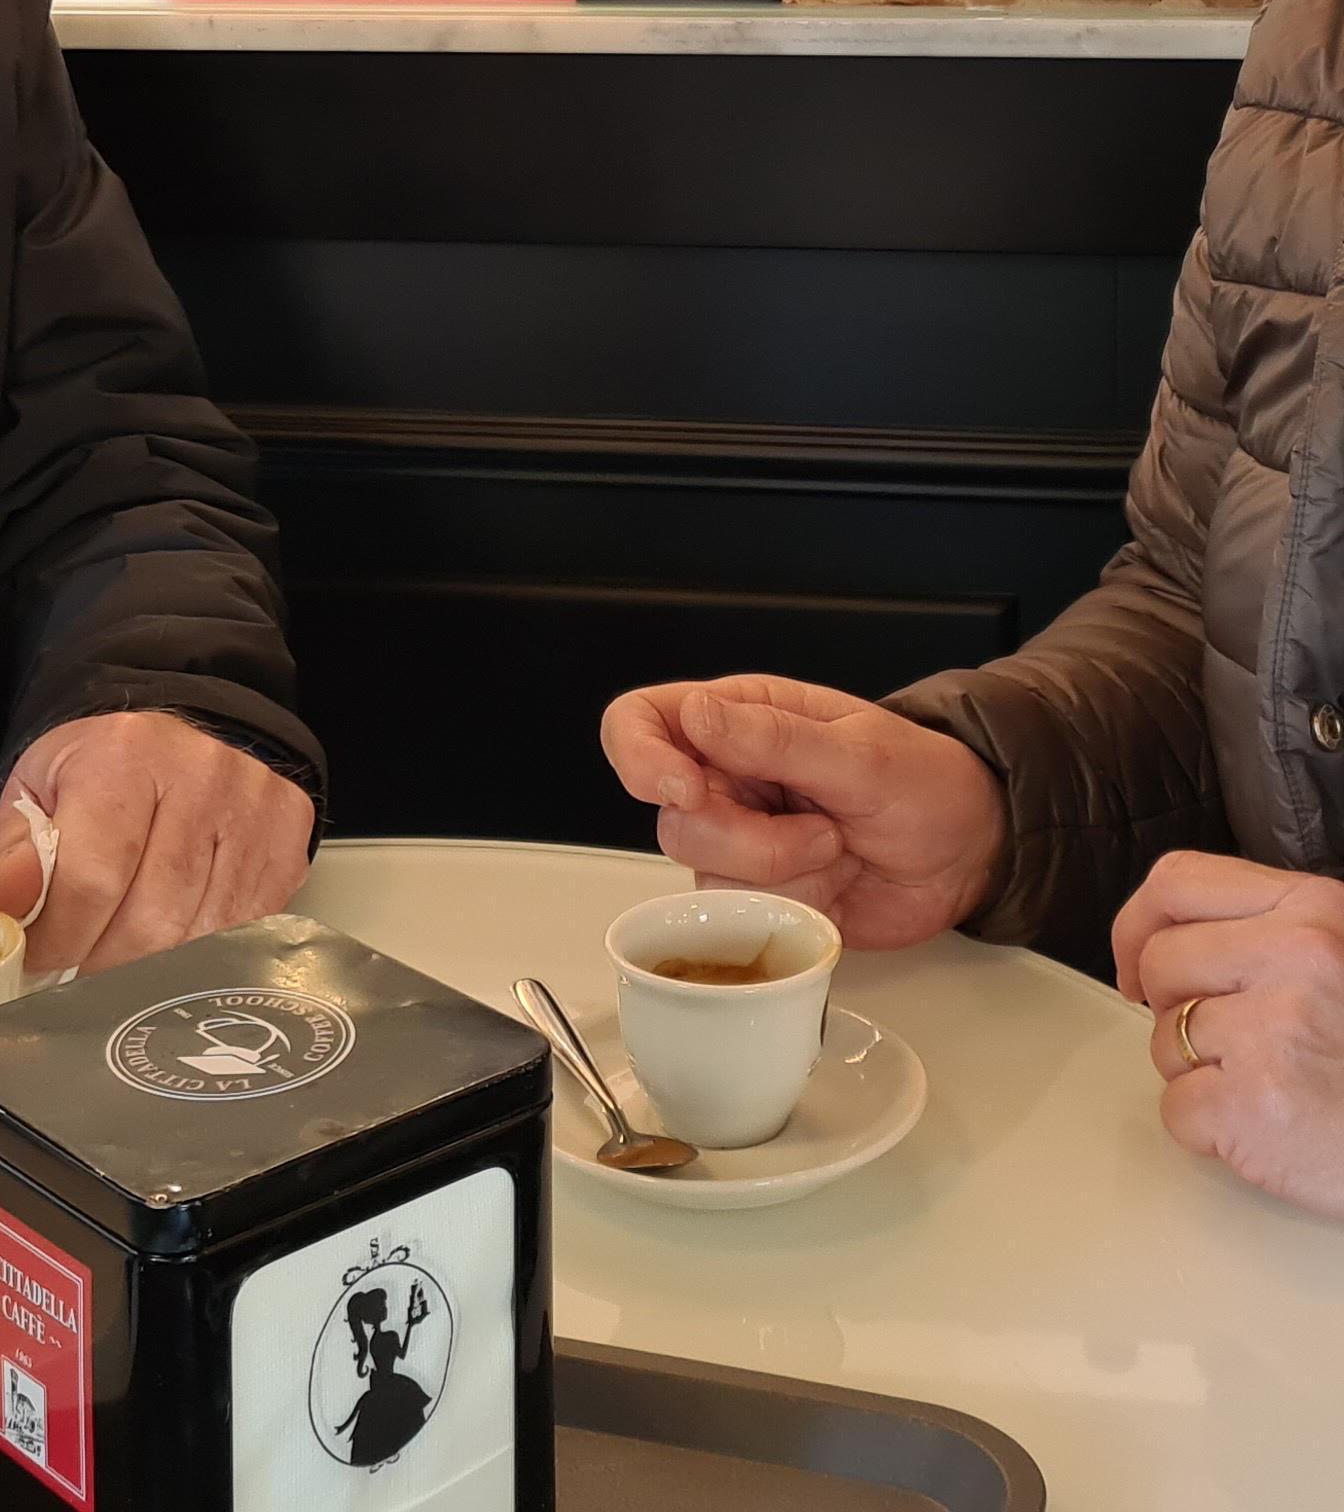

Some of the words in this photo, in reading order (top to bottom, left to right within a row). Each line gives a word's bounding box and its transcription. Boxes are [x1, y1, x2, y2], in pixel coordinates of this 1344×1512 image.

[209, 995, 313, 1016] SCHOOL
[124, 1025, 205, 1091] CITTADELLA
[303, 1014, 335, 1063] COFFEE
[216, 1078, 251, 1091] LA
[1, 1293, 47, 1346] CAFFÈ
